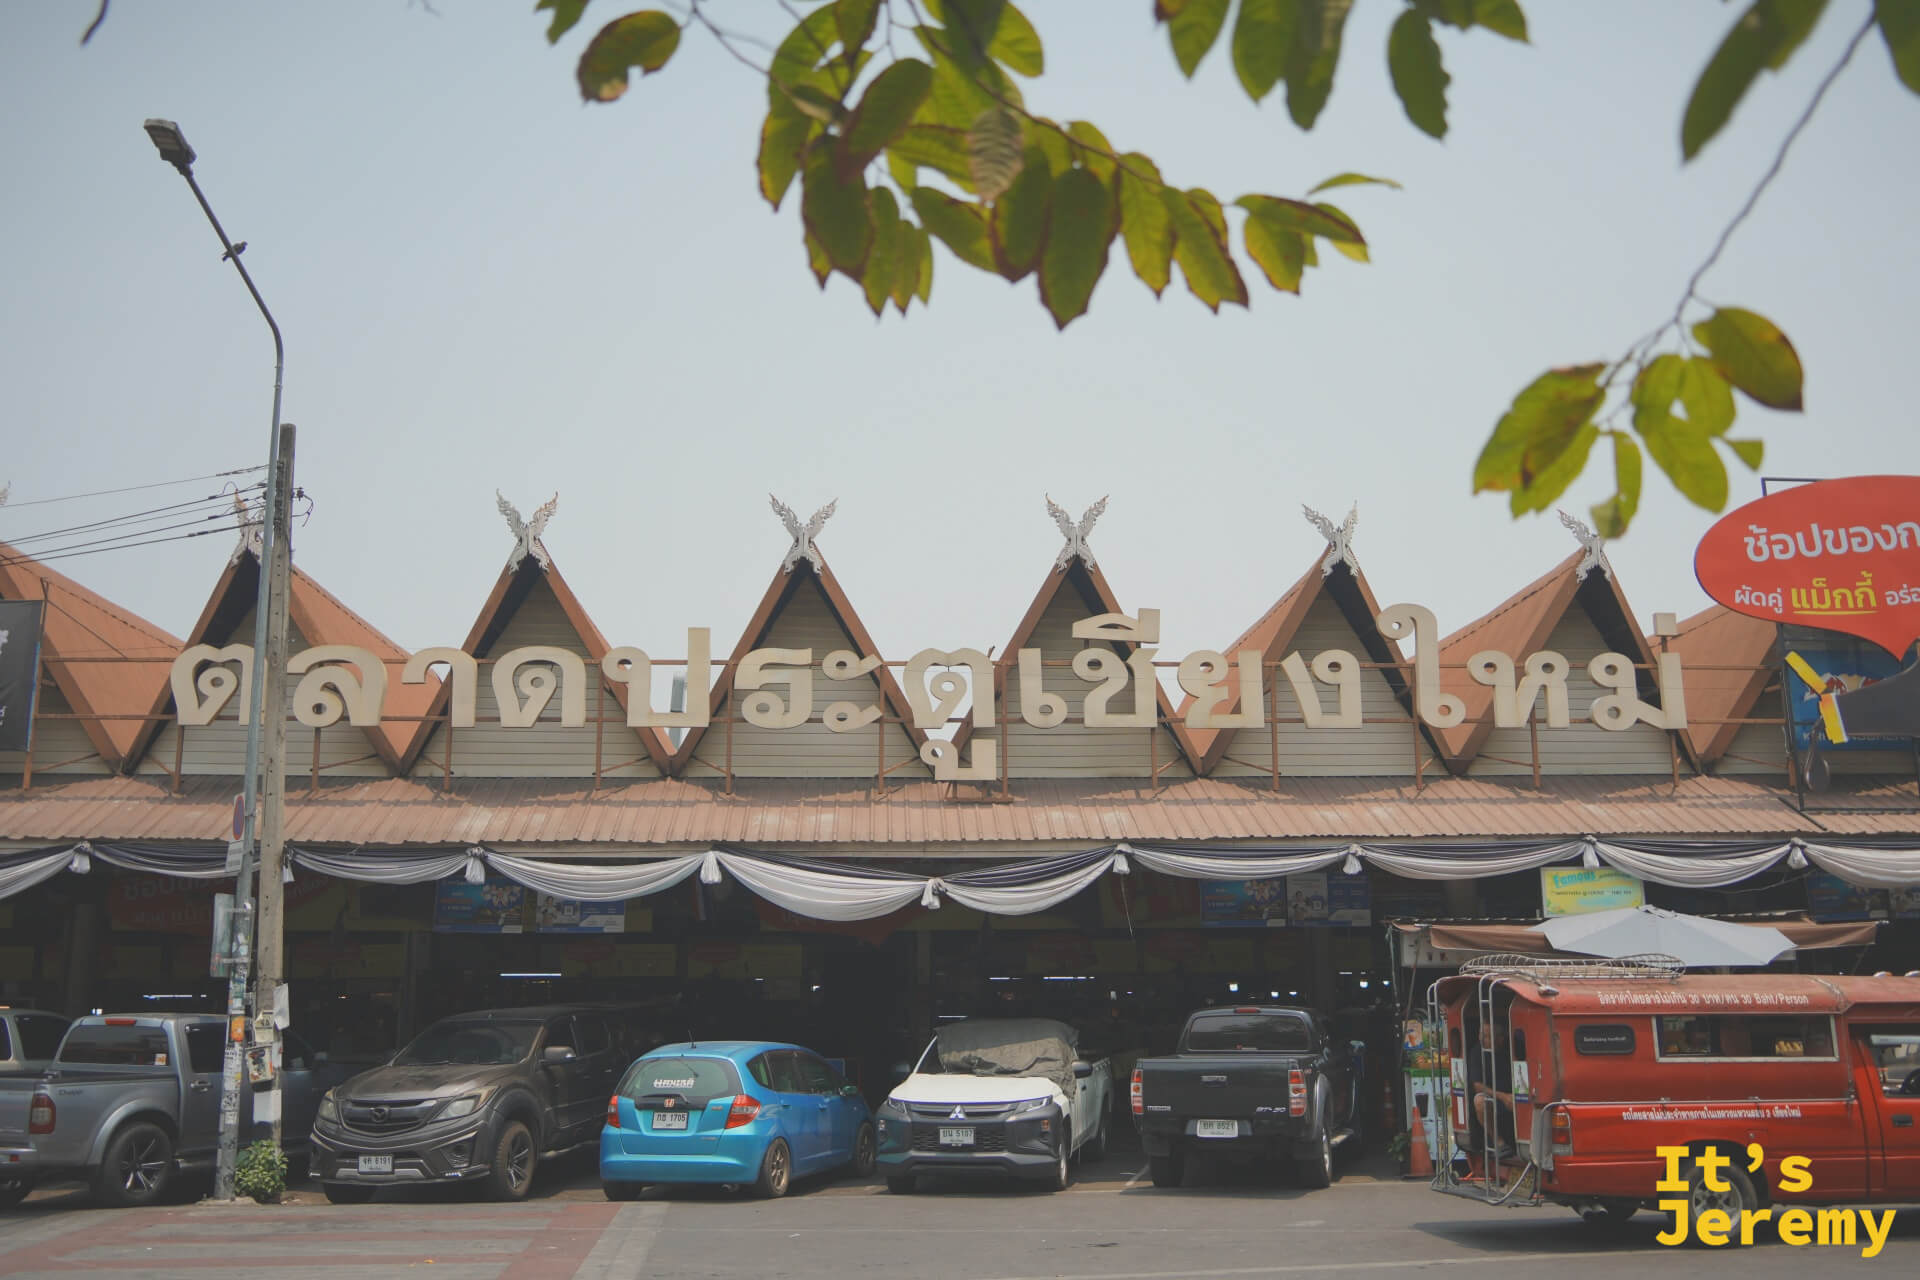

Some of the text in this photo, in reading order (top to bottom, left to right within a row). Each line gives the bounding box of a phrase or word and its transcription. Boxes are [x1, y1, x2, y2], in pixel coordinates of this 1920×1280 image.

[1734, 584, 1783, 614] ผัดคู่
[1791, 570, 1877, 610] แม็กกี้
[170, 603, 1688, 781] ตลาดประตูเชียงใหม่
